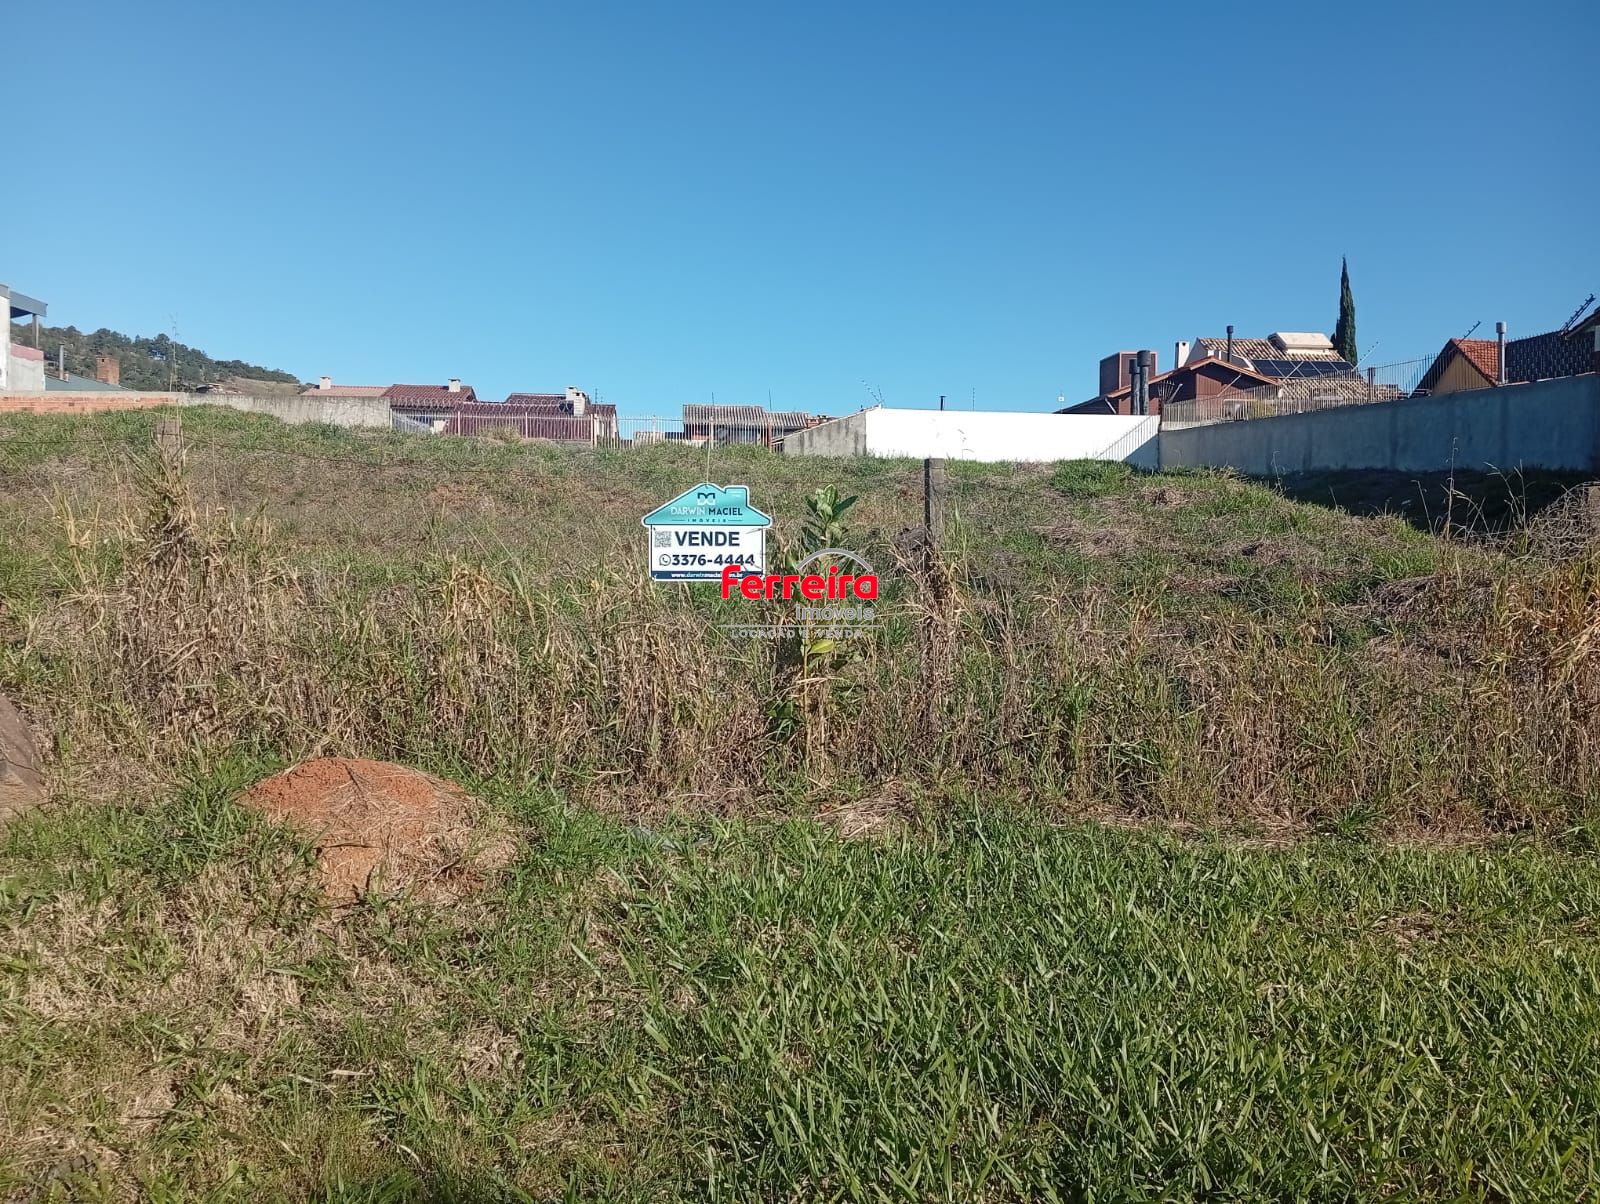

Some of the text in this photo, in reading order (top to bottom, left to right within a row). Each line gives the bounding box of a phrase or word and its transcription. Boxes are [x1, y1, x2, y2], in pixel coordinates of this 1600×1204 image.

[671, 506, 743, 516] DARWIN MACIEL
[674, 531, 740, 547] VENDE
[672, 554, 755, 566] 3376-4444
